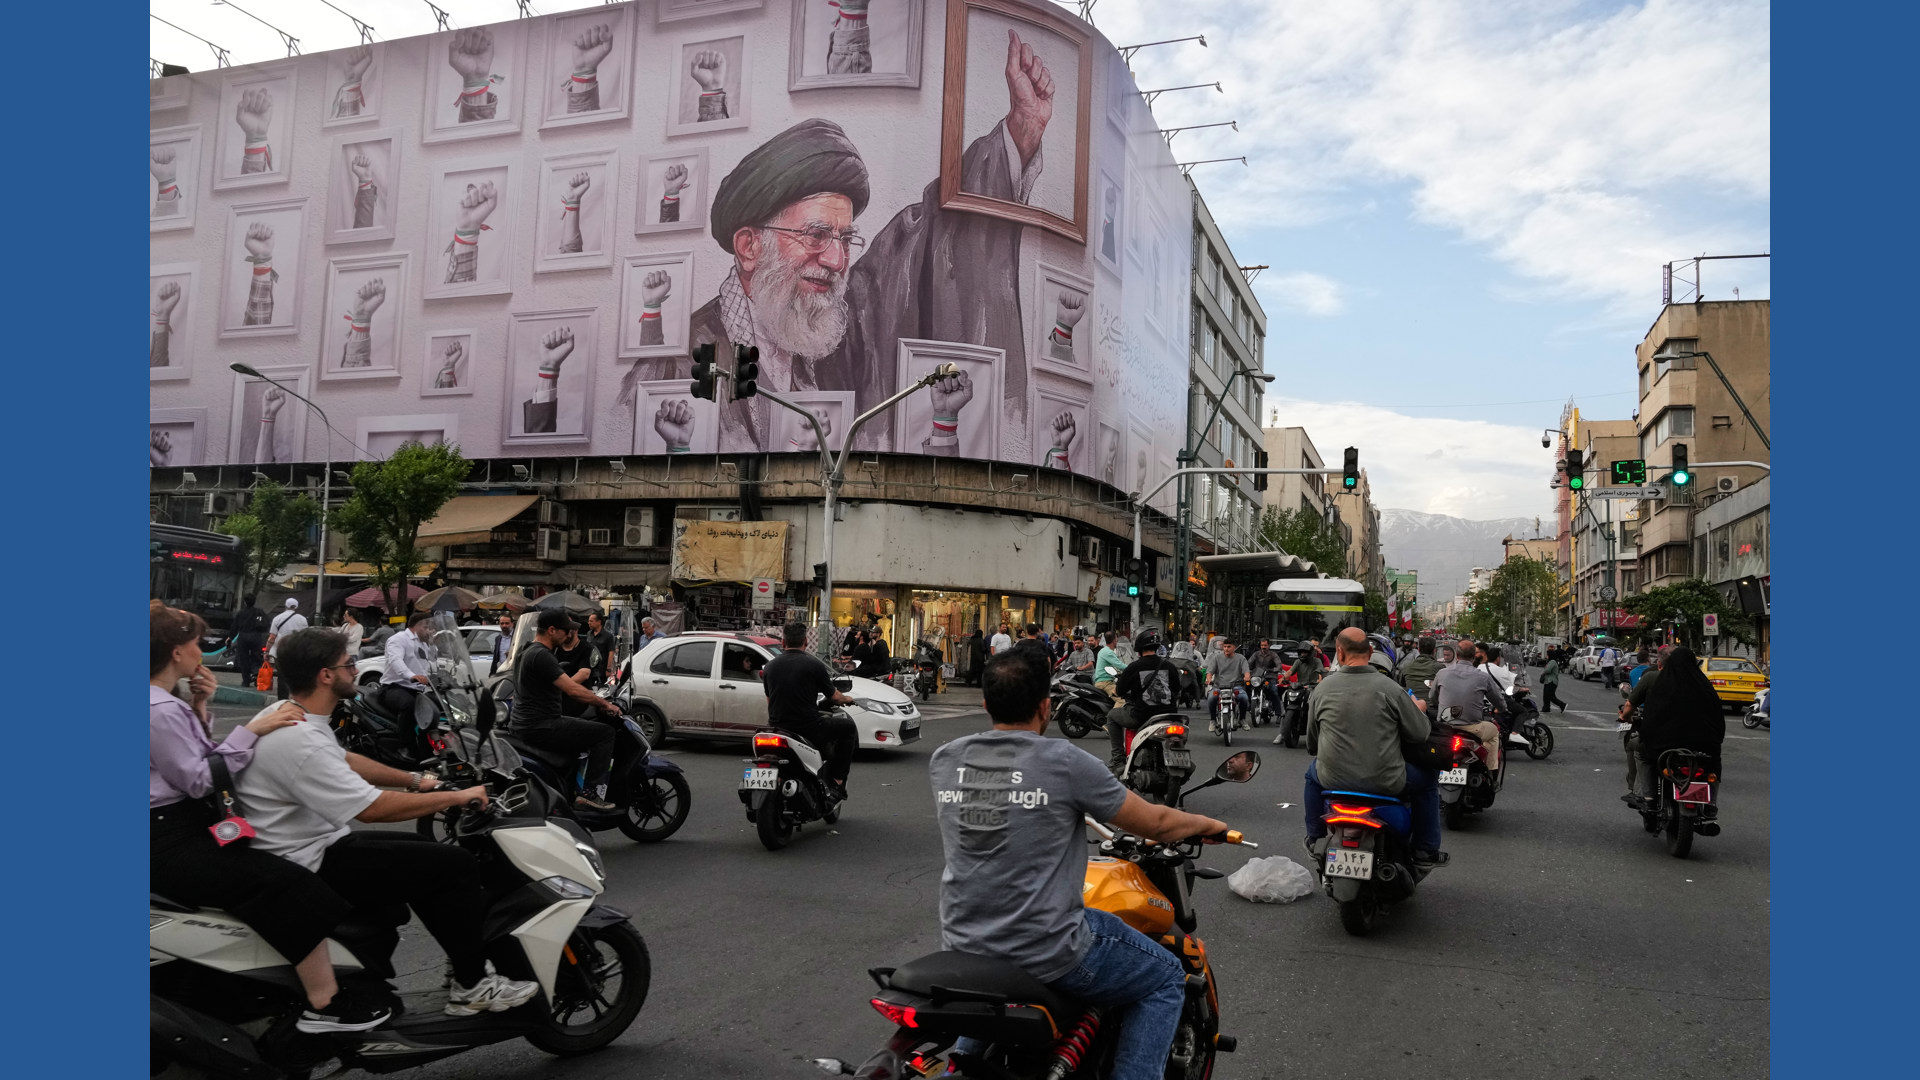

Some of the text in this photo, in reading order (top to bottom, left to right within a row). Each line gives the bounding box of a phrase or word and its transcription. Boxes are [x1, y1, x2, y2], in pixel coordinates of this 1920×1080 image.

[1616, 461, 1645, 484] 53
[1343, 851, 1366, 864] ۱۴۴
[1328, 863, 1369, 877] ۵۶۵۷۳
